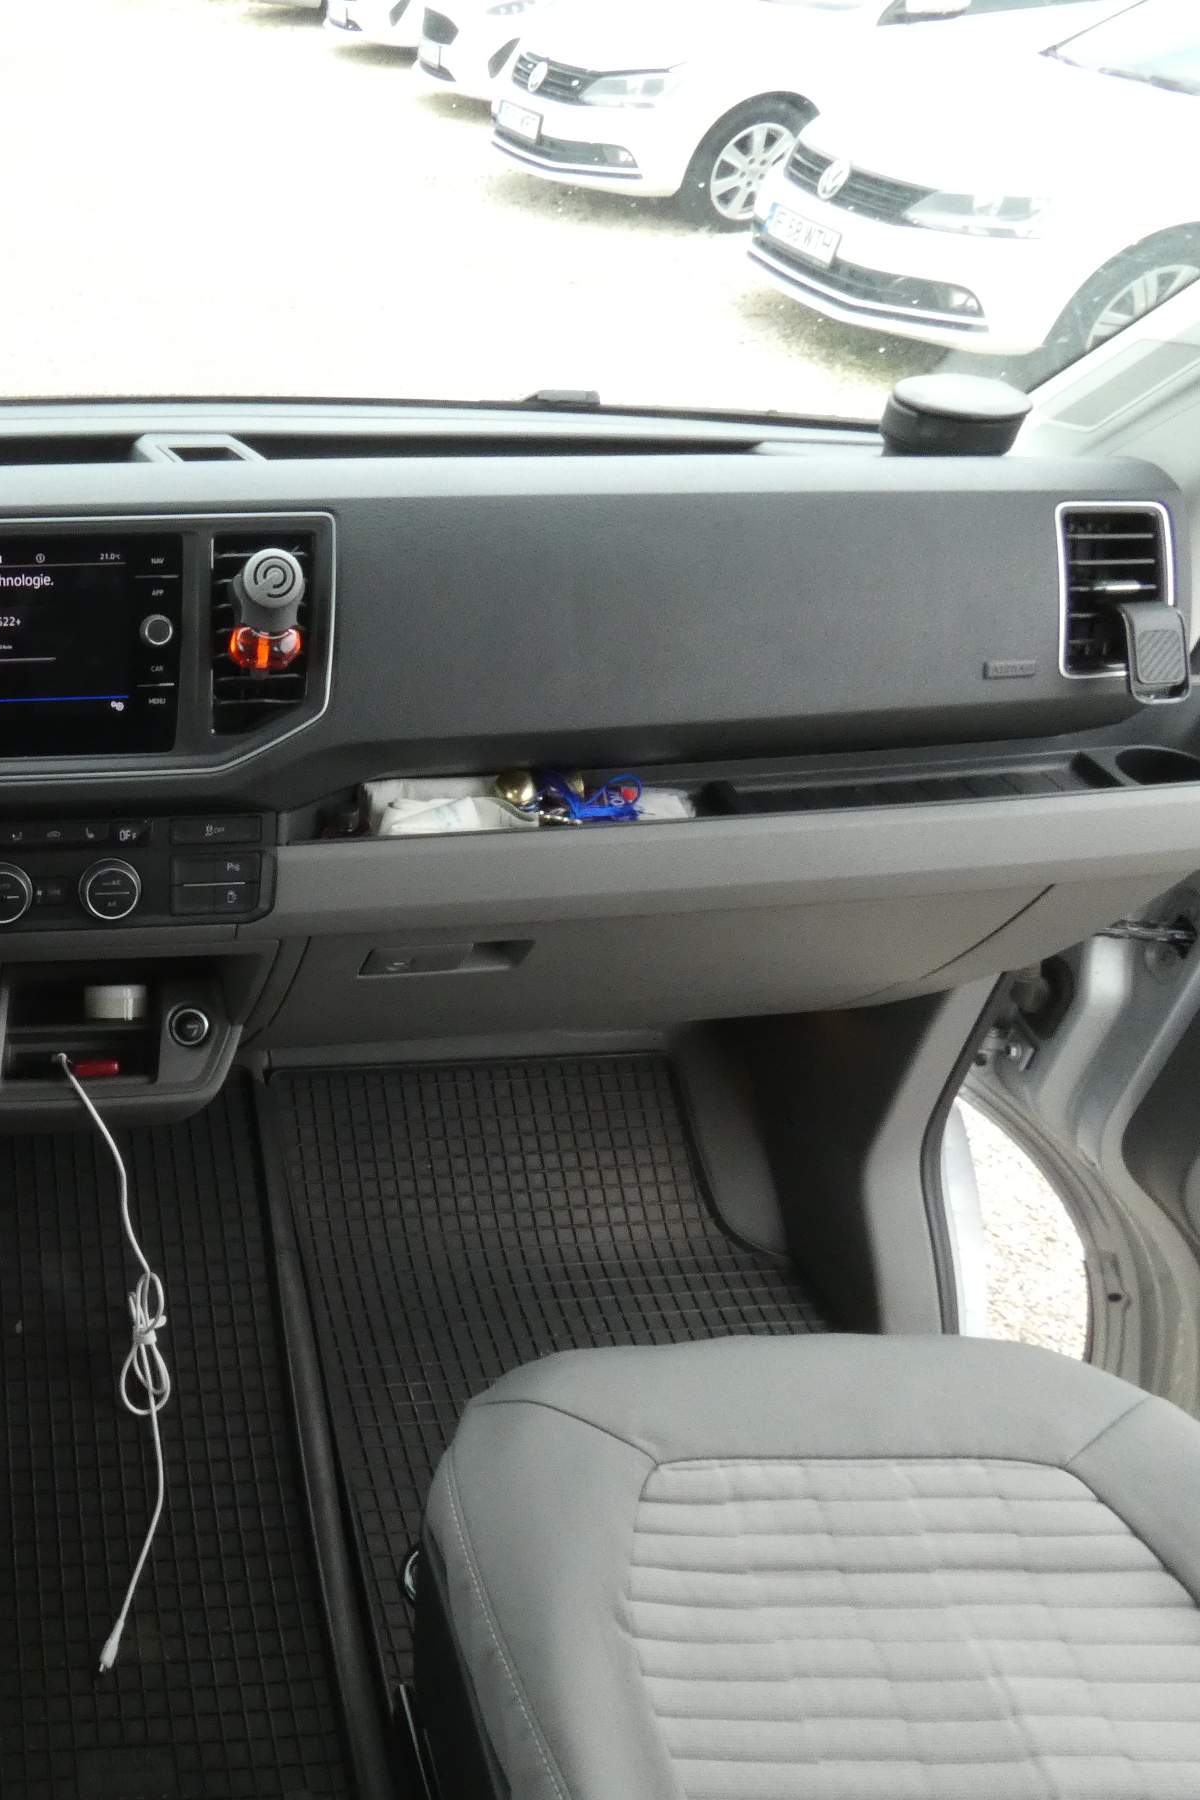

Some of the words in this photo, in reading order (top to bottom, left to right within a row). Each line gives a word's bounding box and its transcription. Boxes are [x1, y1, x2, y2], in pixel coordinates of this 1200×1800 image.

[150, 557, 165, 565] NAV
[151, 588, 165, 596] APP
[150, 665, 164, 673] CAR
[148, 697, 167, 705] MENU
